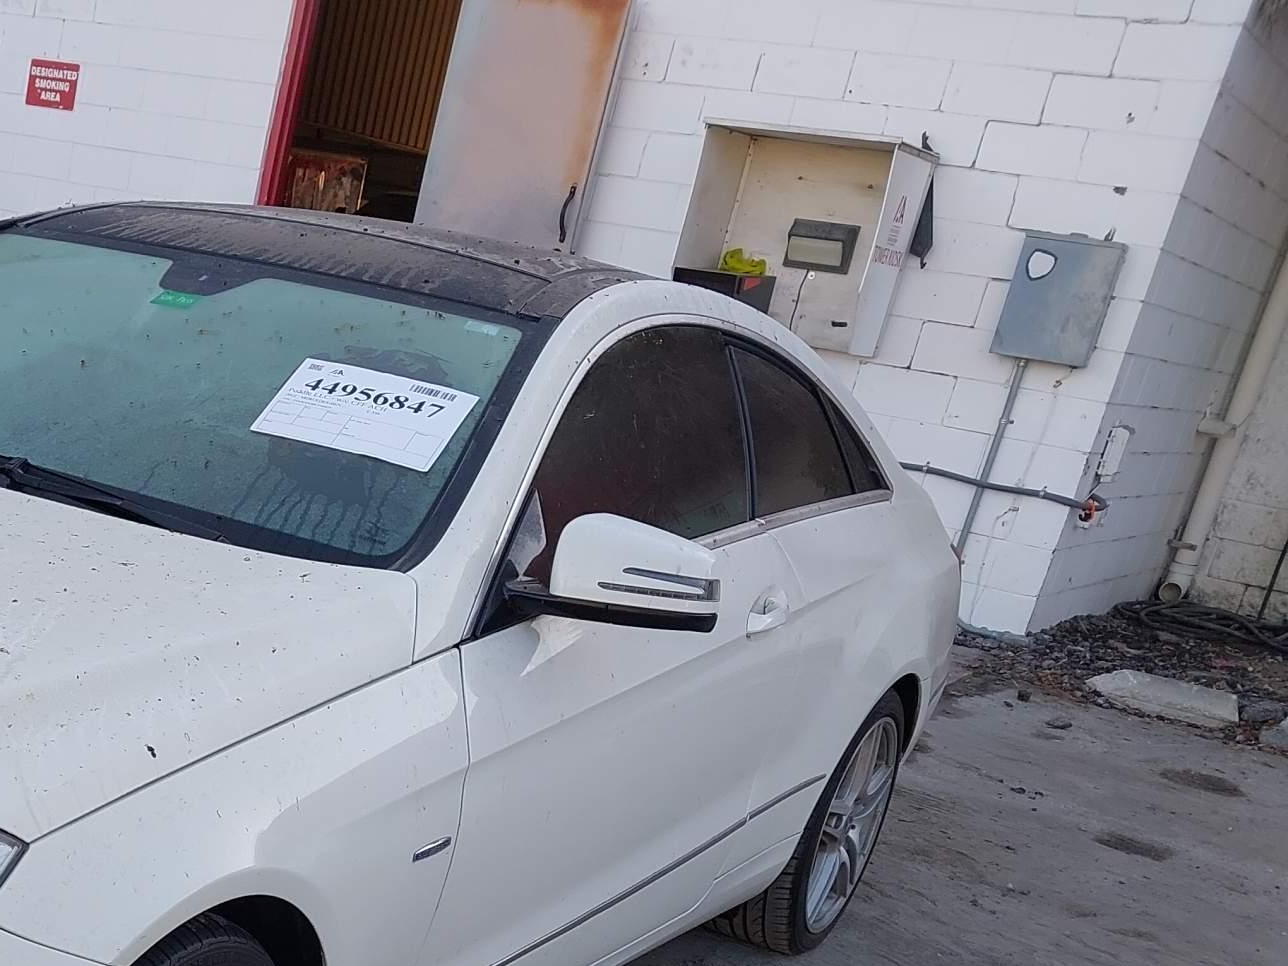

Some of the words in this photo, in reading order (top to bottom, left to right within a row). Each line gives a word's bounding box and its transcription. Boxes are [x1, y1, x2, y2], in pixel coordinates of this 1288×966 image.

[31, 66, 78, 80] DESIGNATED
[34, 78, 70, 92] SMOKING
[40, 90, 60, 102] AREA
[305, 378, 446, 418] 44956847
